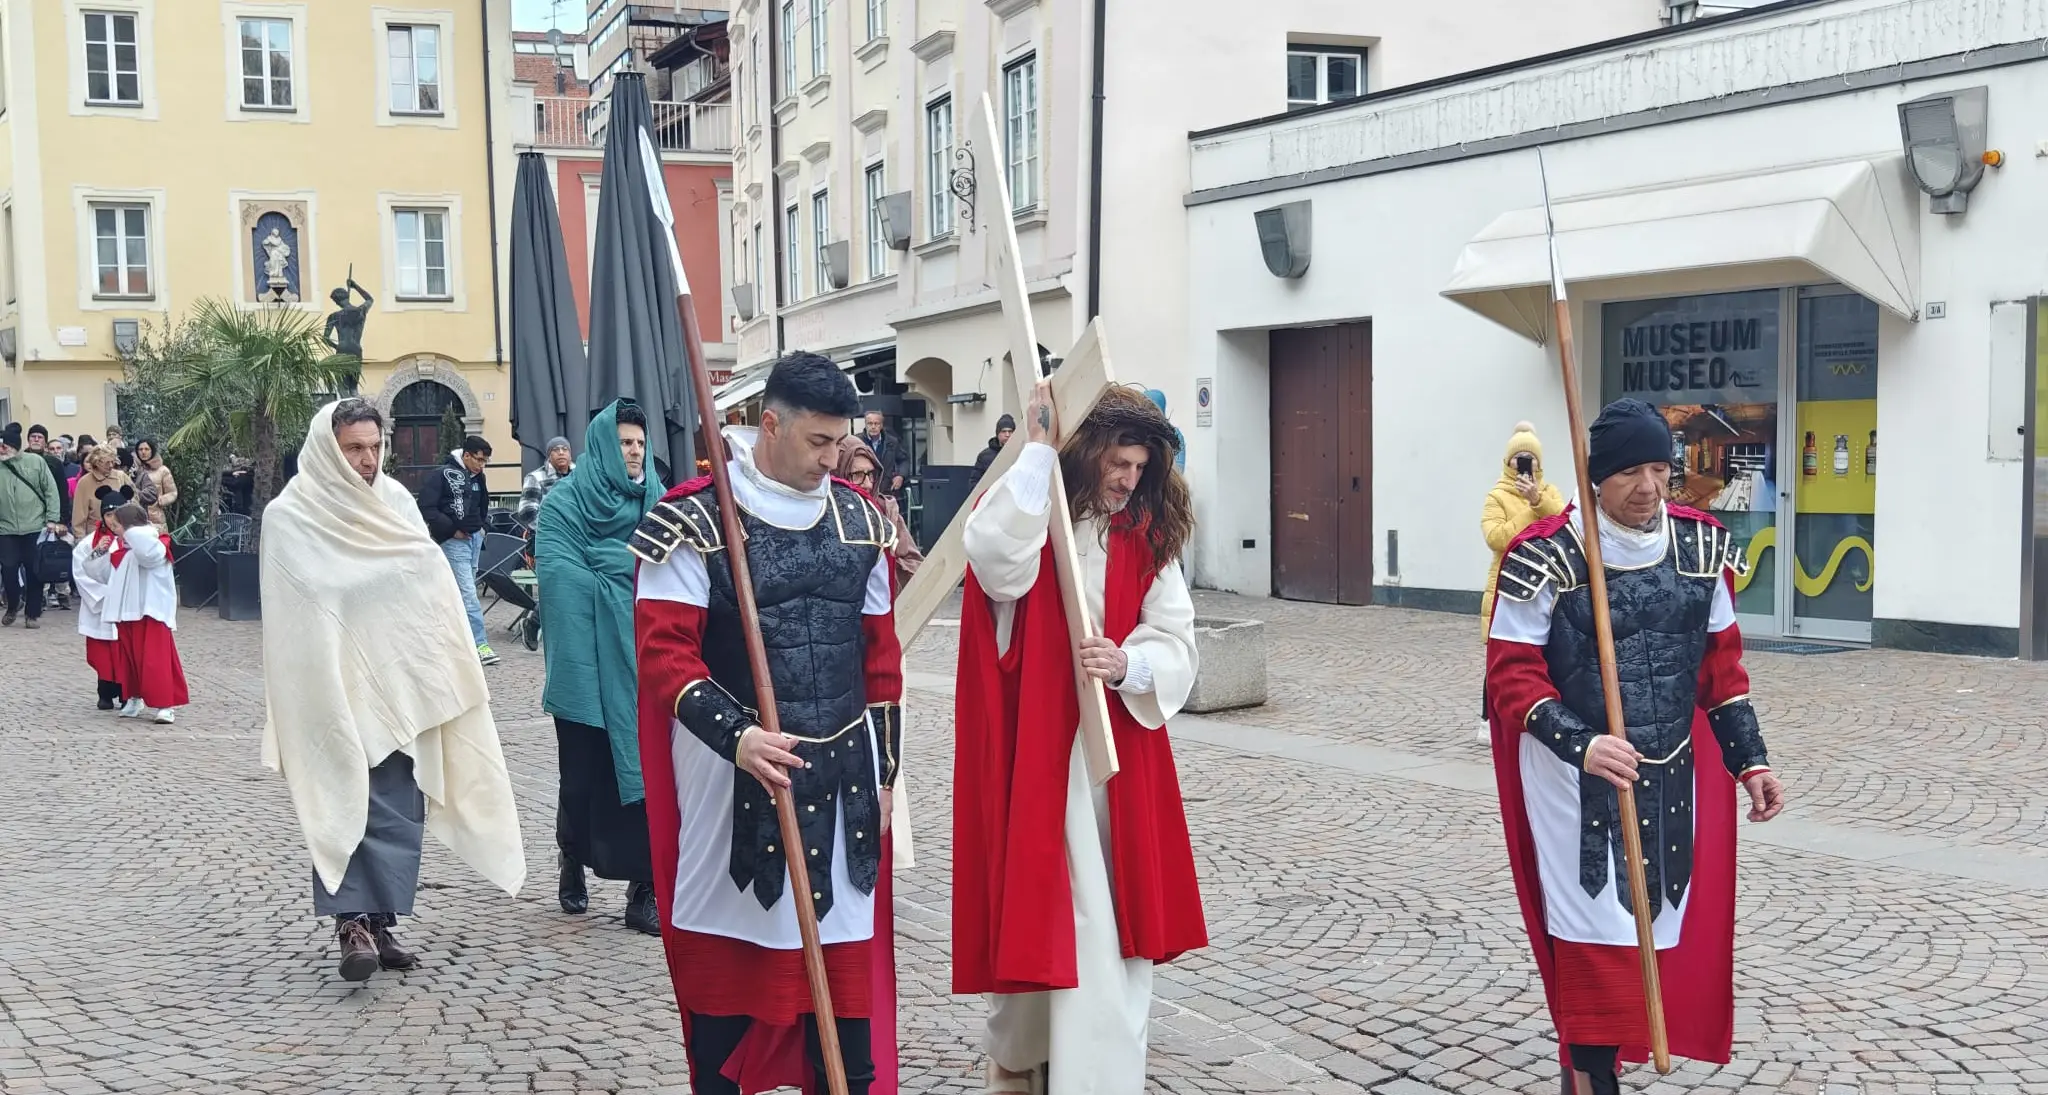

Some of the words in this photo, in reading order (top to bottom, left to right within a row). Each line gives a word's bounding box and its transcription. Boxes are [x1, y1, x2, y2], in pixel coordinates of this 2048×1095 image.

[1623, 318, 1756, 357] MUSEUM
[708, 371, 731, 383] Mas
[1623, 357, 1726, 392] MUSEO
